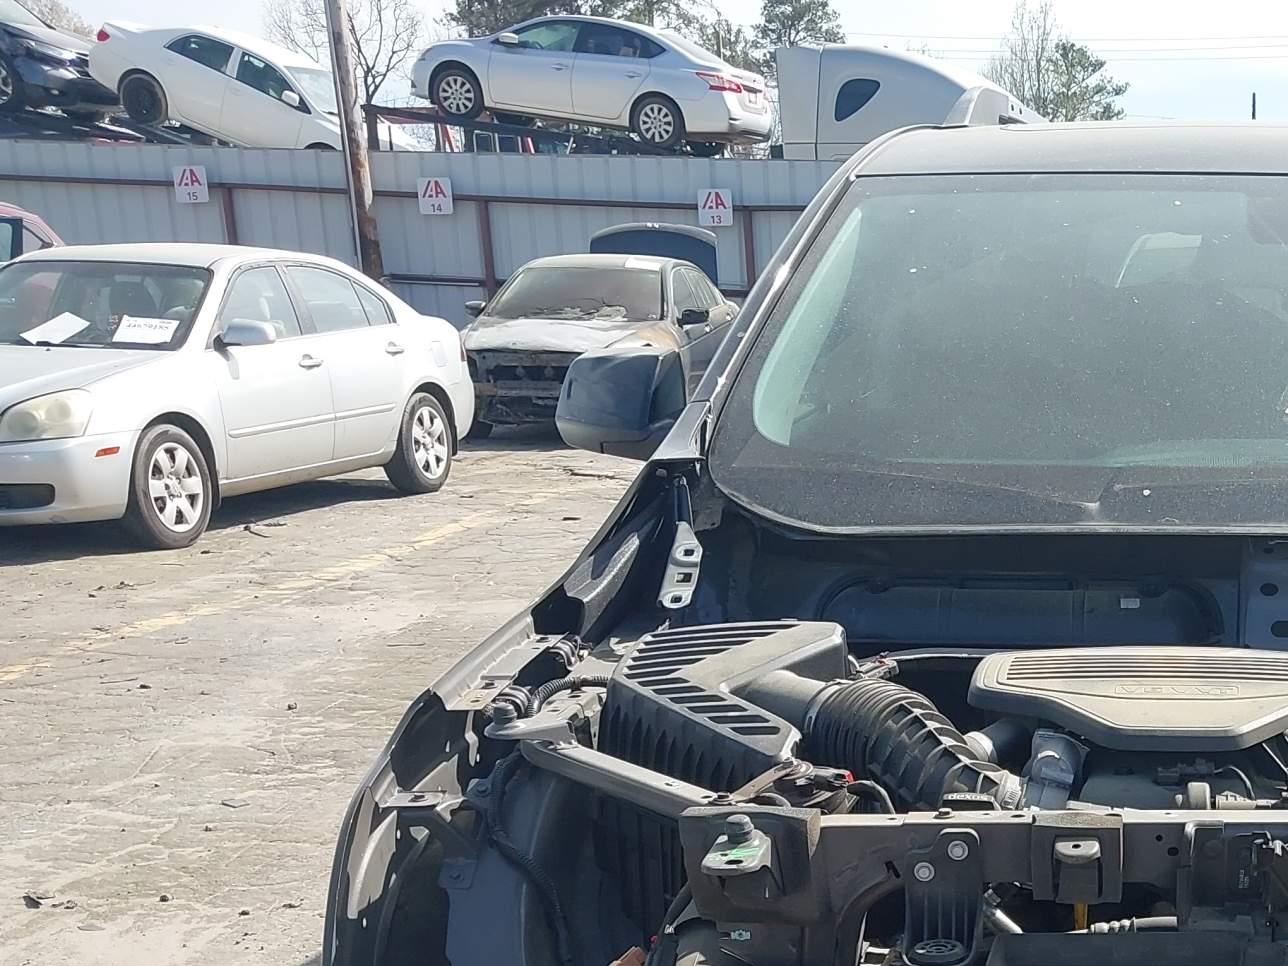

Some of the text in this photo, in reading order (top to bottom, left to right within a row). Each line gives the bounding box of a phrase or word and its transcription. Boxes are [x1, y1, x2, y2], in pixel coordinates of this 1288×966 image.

[187, 191, 198, 201] 15
[430, 203, 442, 213] 14
[710, 215, 722, 225] 13
